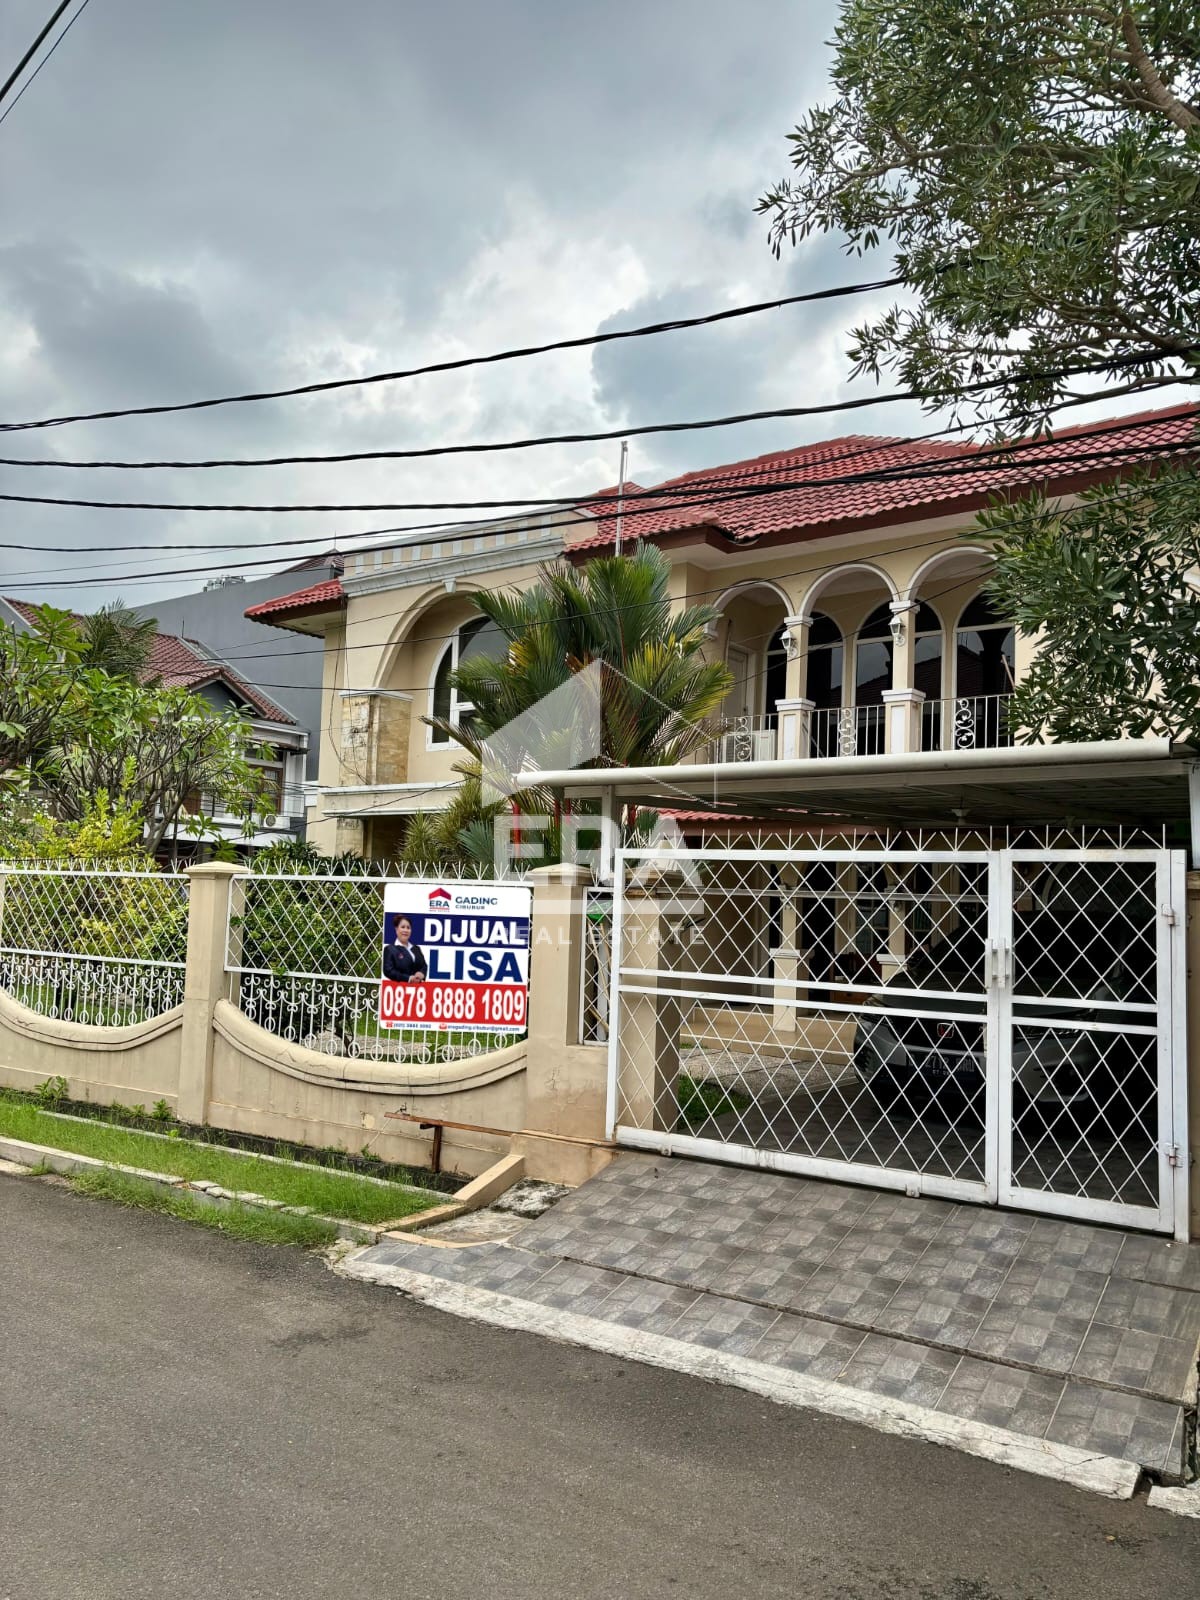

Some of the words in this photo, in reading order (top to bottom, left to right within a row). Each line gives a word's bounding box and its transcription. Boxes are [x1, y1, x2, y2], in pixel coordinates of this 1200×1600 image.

[429, 900, 450, 908] ERA
[455, 896, 498, 906] GADING
[423, 918, 526, 945] DIJUAL
[428, 949, 523, 983] LISA
[383, 985, 427, 1018] 0878
[432, 986, 475, 1020] 8888
[482, 988, 524, 1022] 1809
